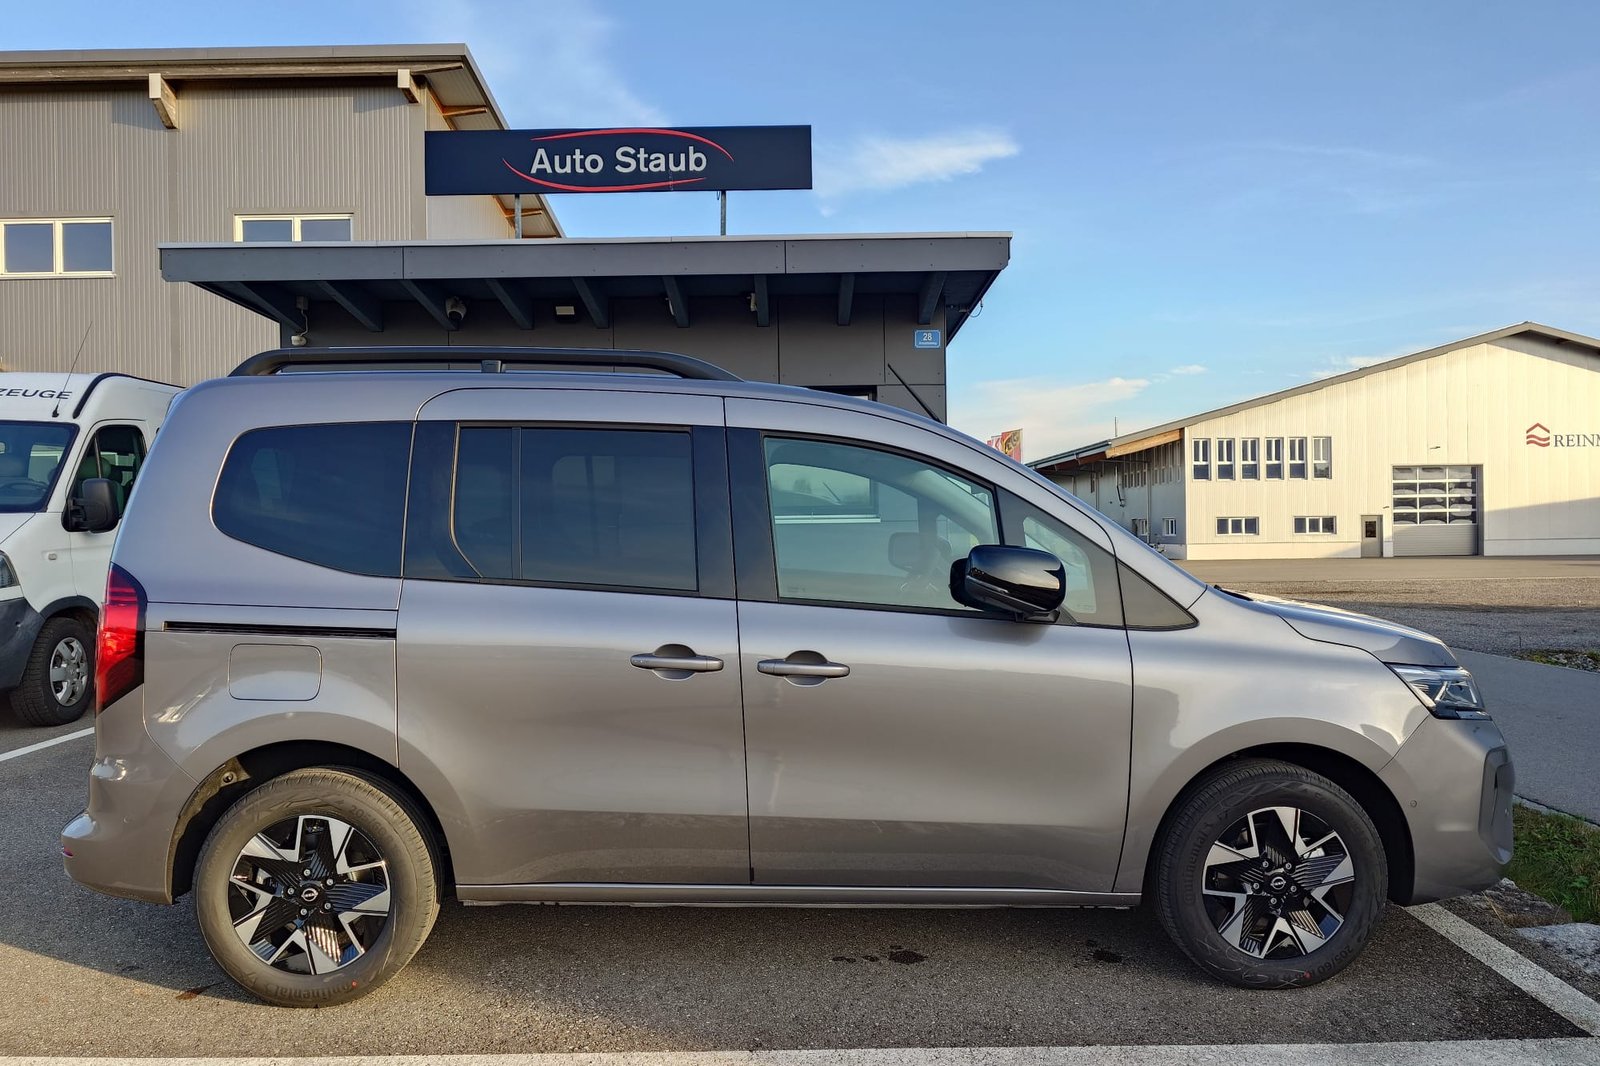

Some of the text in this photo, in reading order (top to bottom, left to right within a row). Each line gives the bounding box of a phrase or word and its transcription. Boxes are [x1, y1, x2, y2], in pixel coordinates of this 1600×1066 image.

[530, 146, 707, 174] Auto Staub
[922, 332, 933, 341] 28
